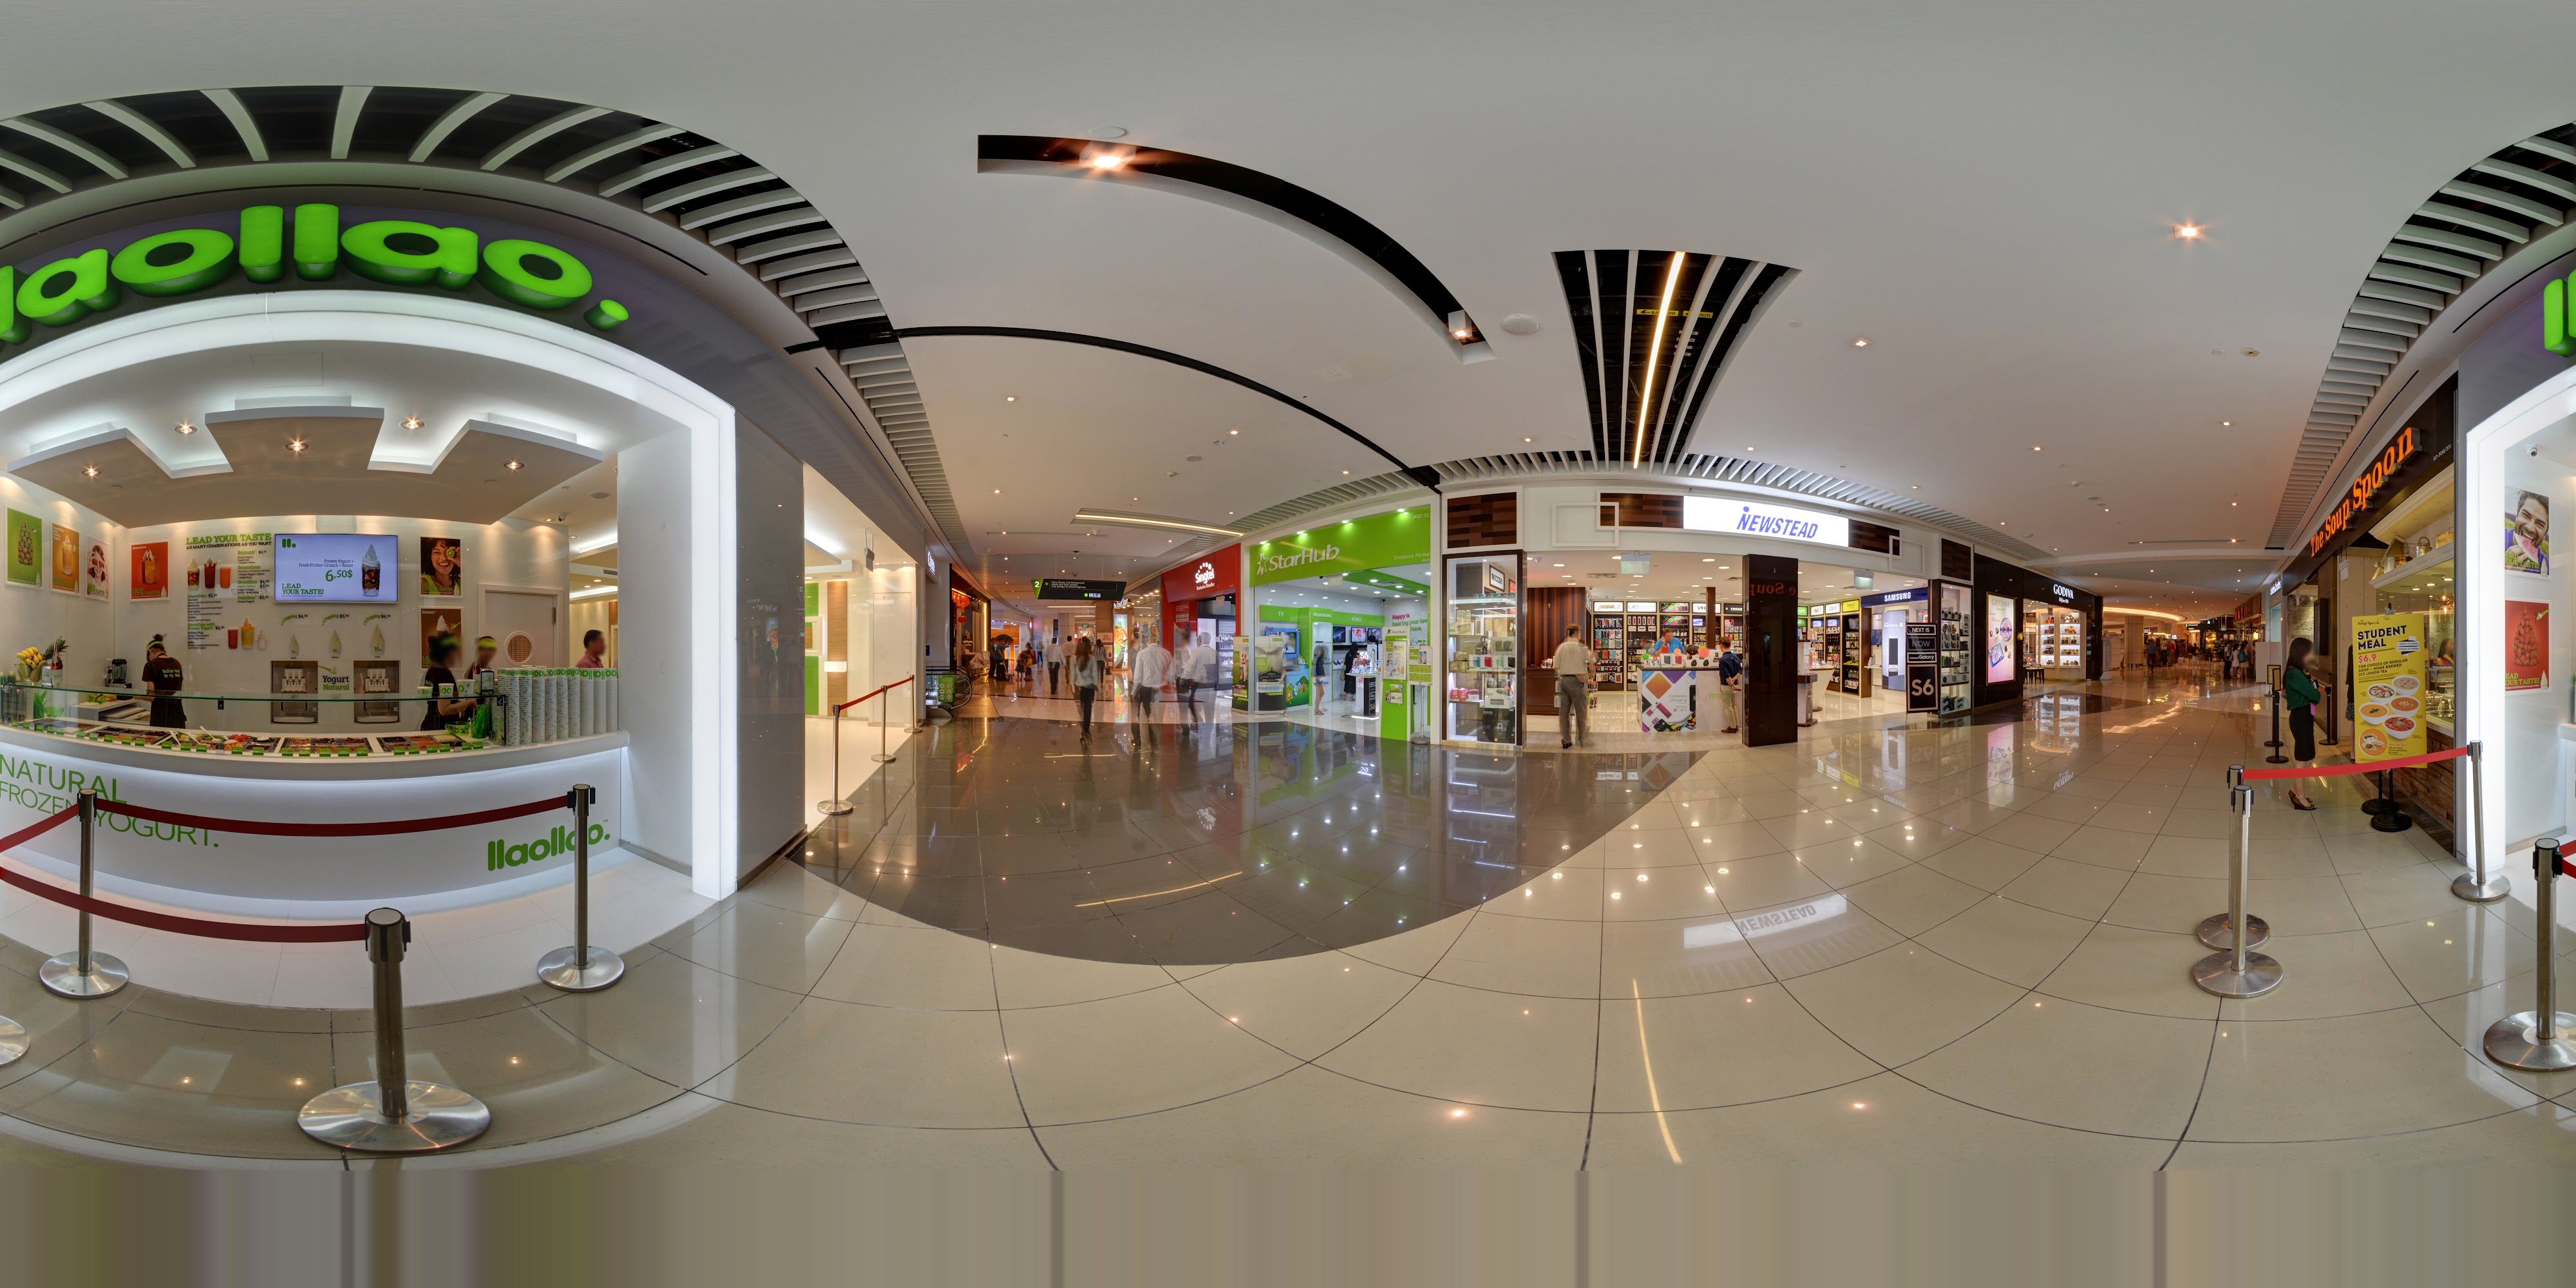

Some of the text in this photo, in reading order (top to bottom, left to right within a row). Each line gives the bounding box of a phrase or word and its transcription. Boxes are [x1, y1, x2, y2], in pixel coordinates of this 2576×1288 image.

[2311, 427, 2414, 557] The Soup Spoon
[1736, 507, 1818, 538] NEWSTEAD
[186, 533, 272, 545] LEAD YOUR TASTE
[1269, 544, 1340, 571] StarHub
[325, 569, 353, 582] 6,50$
[1195, 568, 1215, 584] Singtel
[1884, 592, 1911, 602] SAMSUNG
[2053, 583, 2074, 600] GODIVA
[1991, 598, 2010, 608] GODIVA
[2357, 625, 2407, 640] STUDENT
[2358, 638, 2387, 650] MEAL
[2358, 654, 2376, 664] $6.9
[322, 676, 350, 684] Yogurt
[1911, 679, 1935, 696] S6
[0, 754, 127, 805] NATURAL
